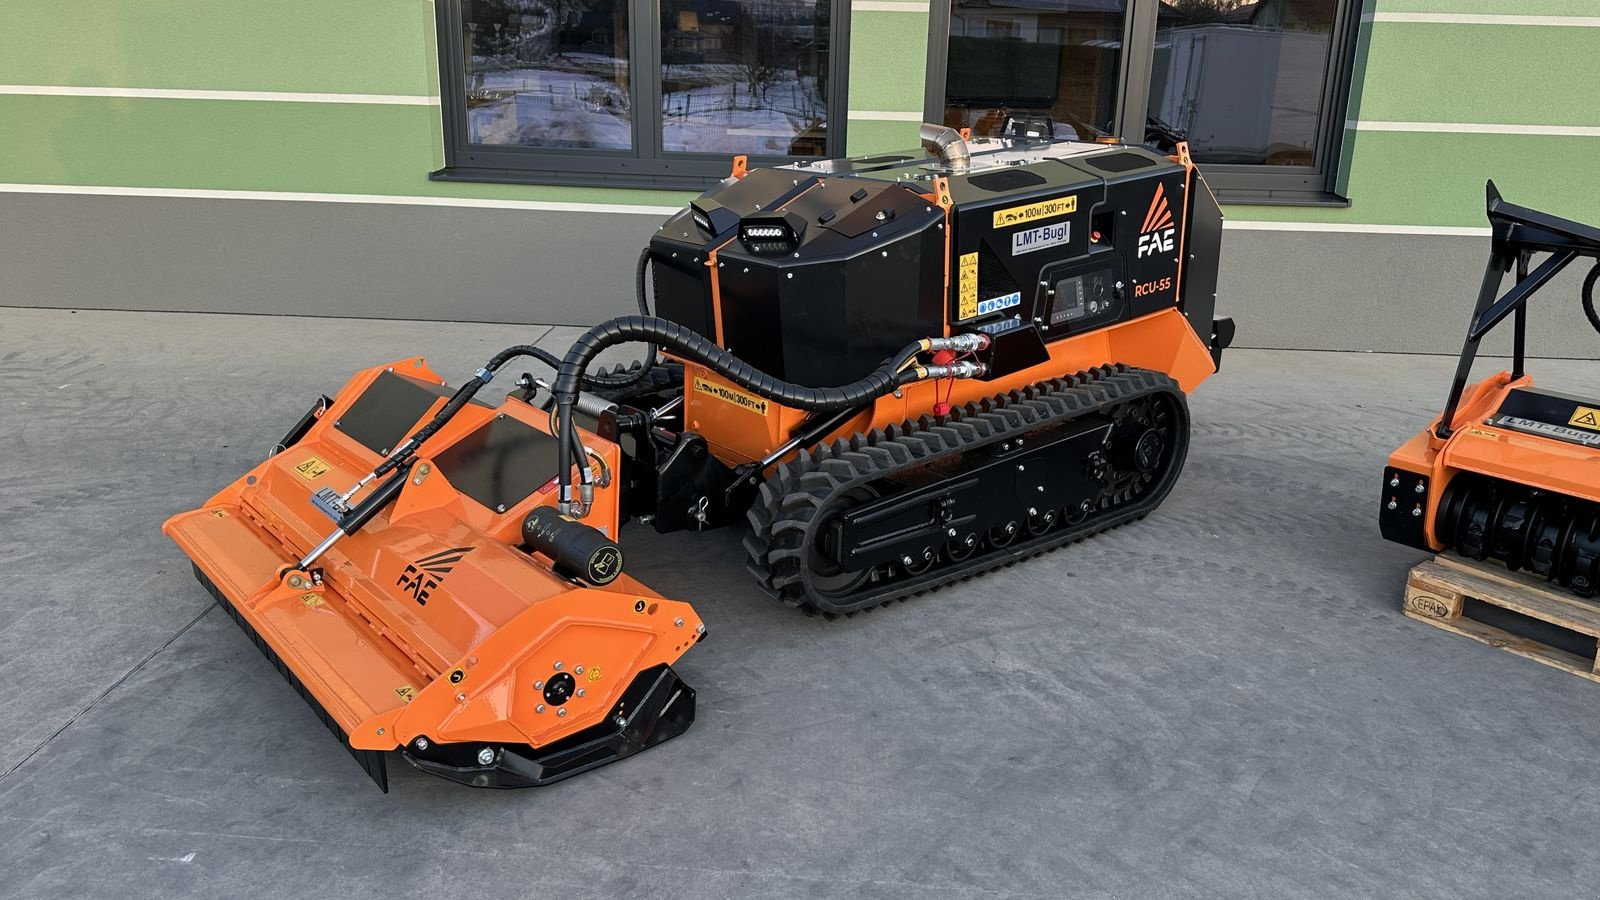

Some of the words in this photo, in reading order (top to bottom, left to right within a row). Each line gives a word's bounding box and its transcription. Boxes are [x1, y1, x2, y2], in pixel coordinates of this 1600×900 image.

[1016, 223, 1067, 247] LMT-Bugl
[1138, 228, 1176, 259] FAE
[1134, 277, 1171, 297] RCU-55
[396, 564, 438, 607] FAE
